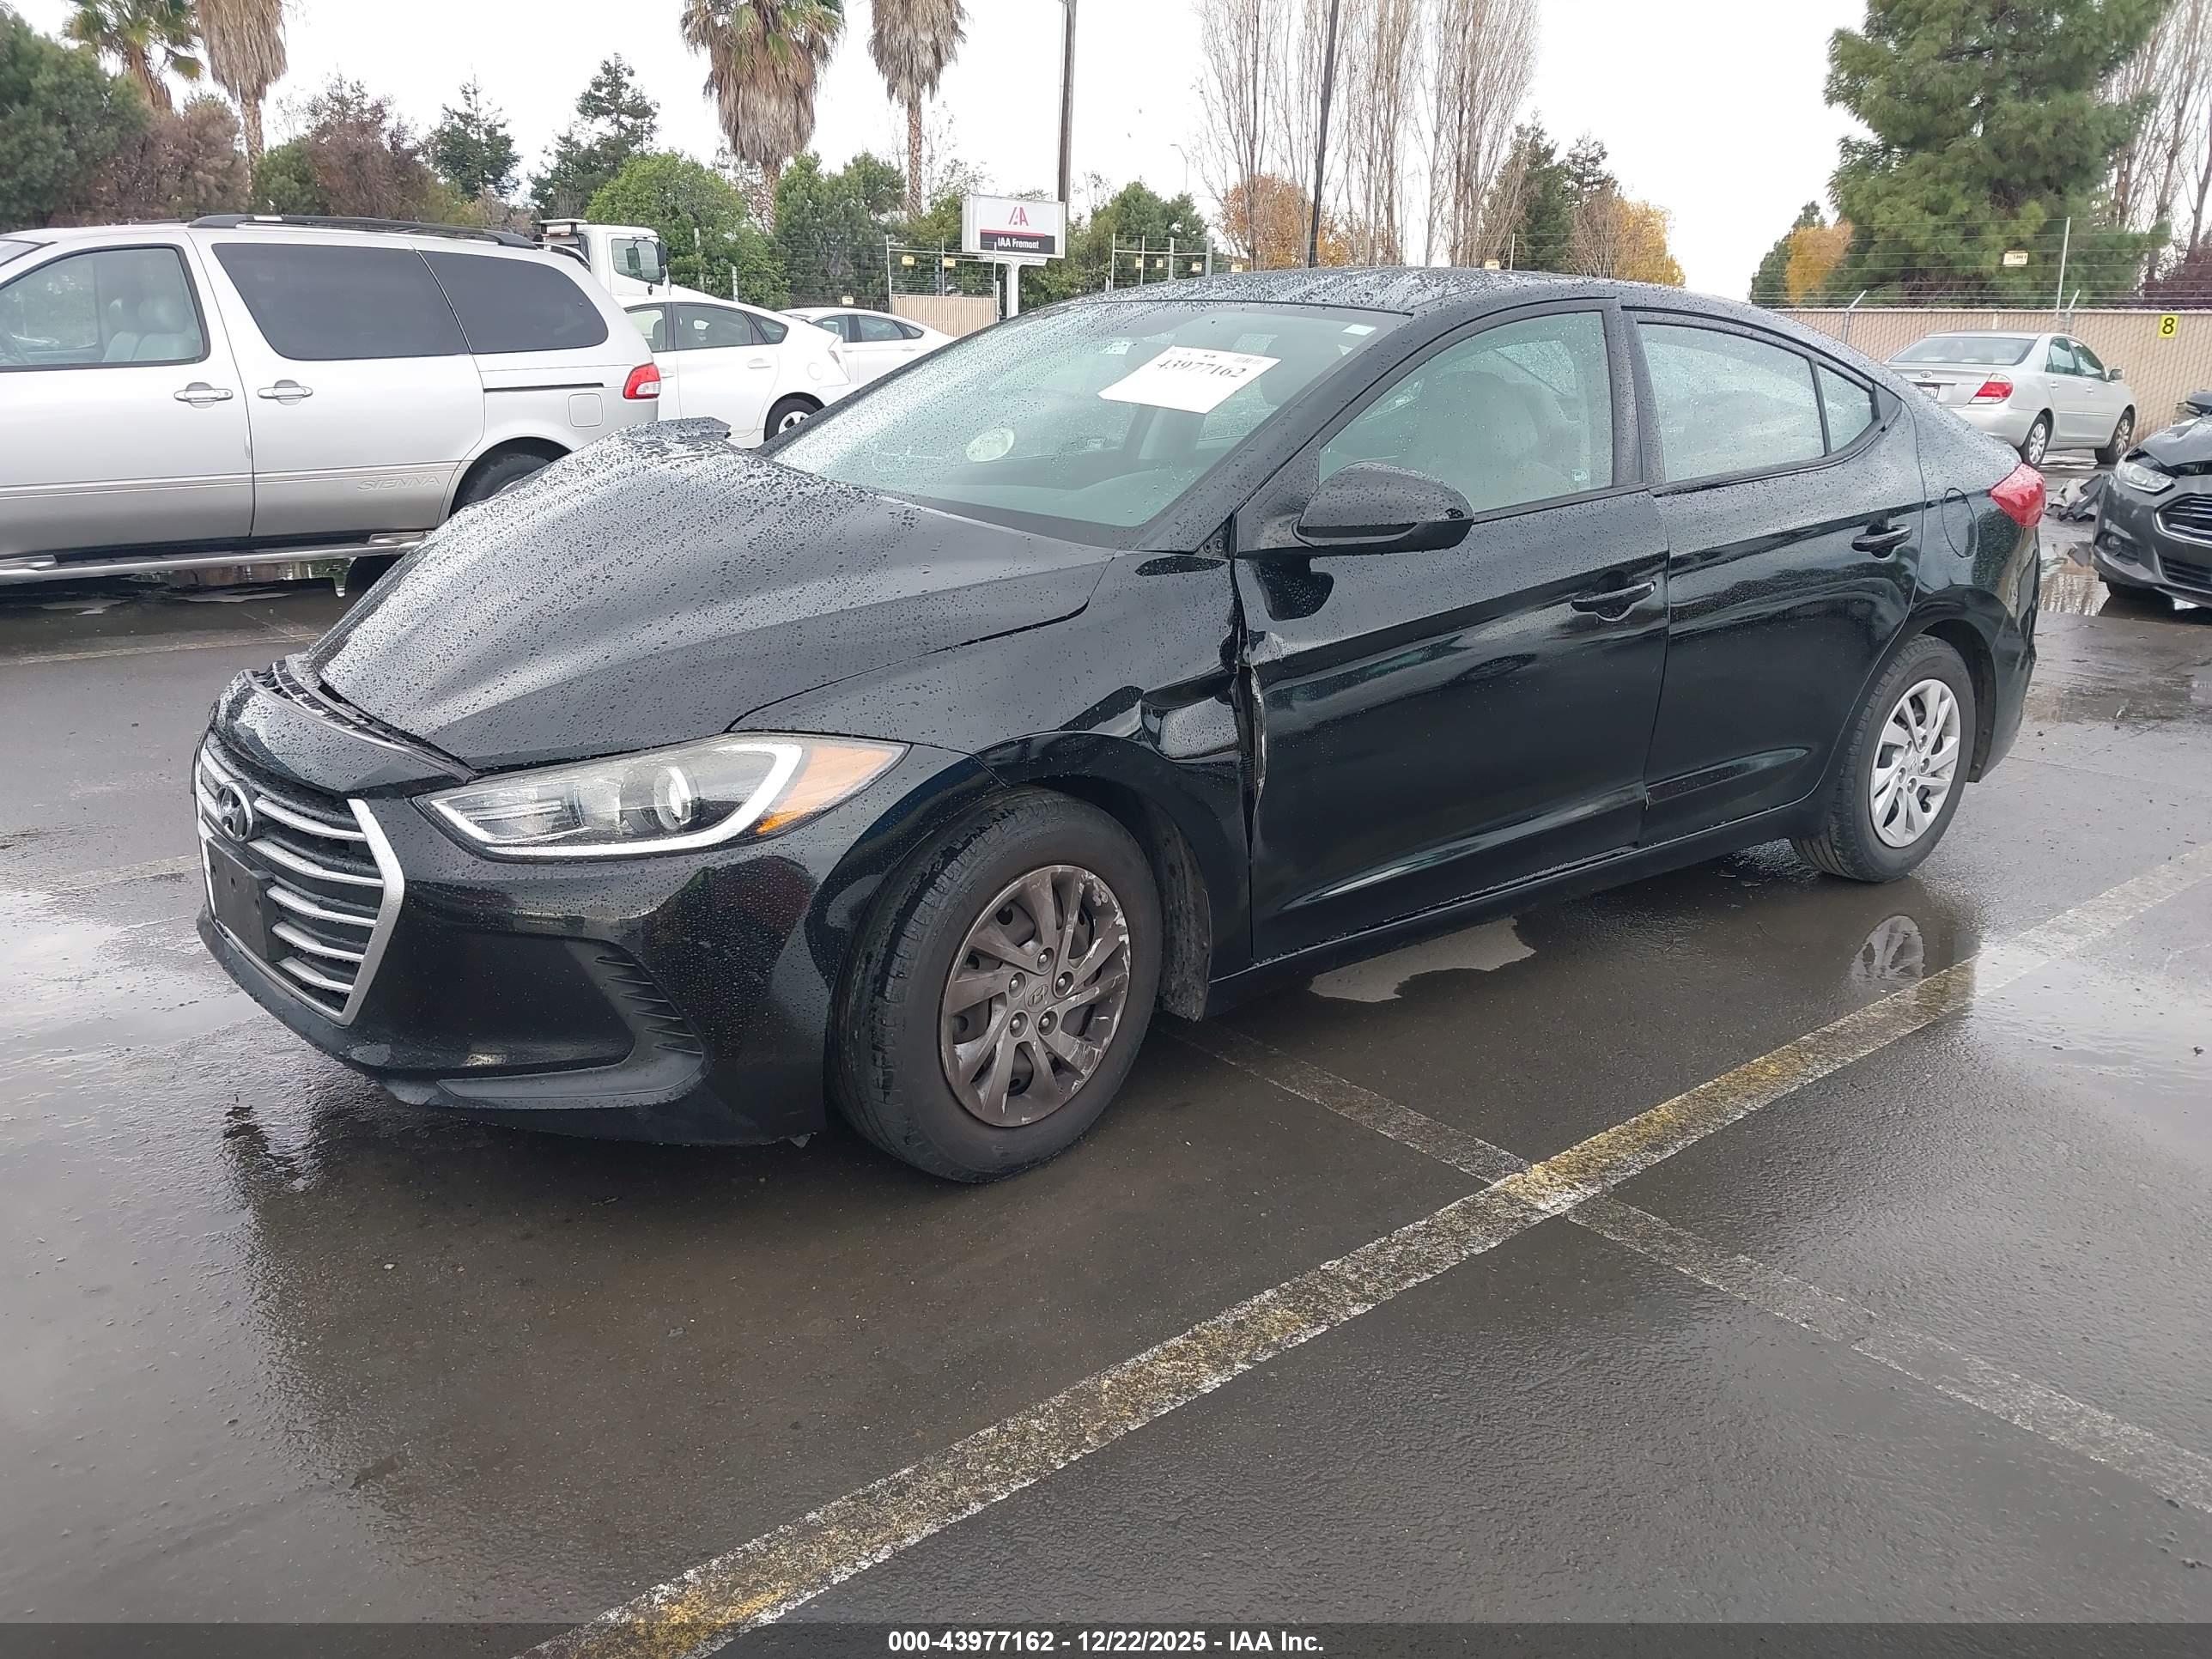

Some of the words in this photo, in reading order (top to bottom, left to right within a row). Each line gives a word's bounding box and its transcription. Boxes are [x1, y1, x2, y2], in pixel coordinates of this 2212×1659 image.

[997, 237, 1012, 247] IAA
[1012, 238, 1040, 249] Fremont
[2162, 317, 2175, 334] 8
[1158, 359, 1247, 378] 43977162
[356, 474, 441, 491] SIENNA
